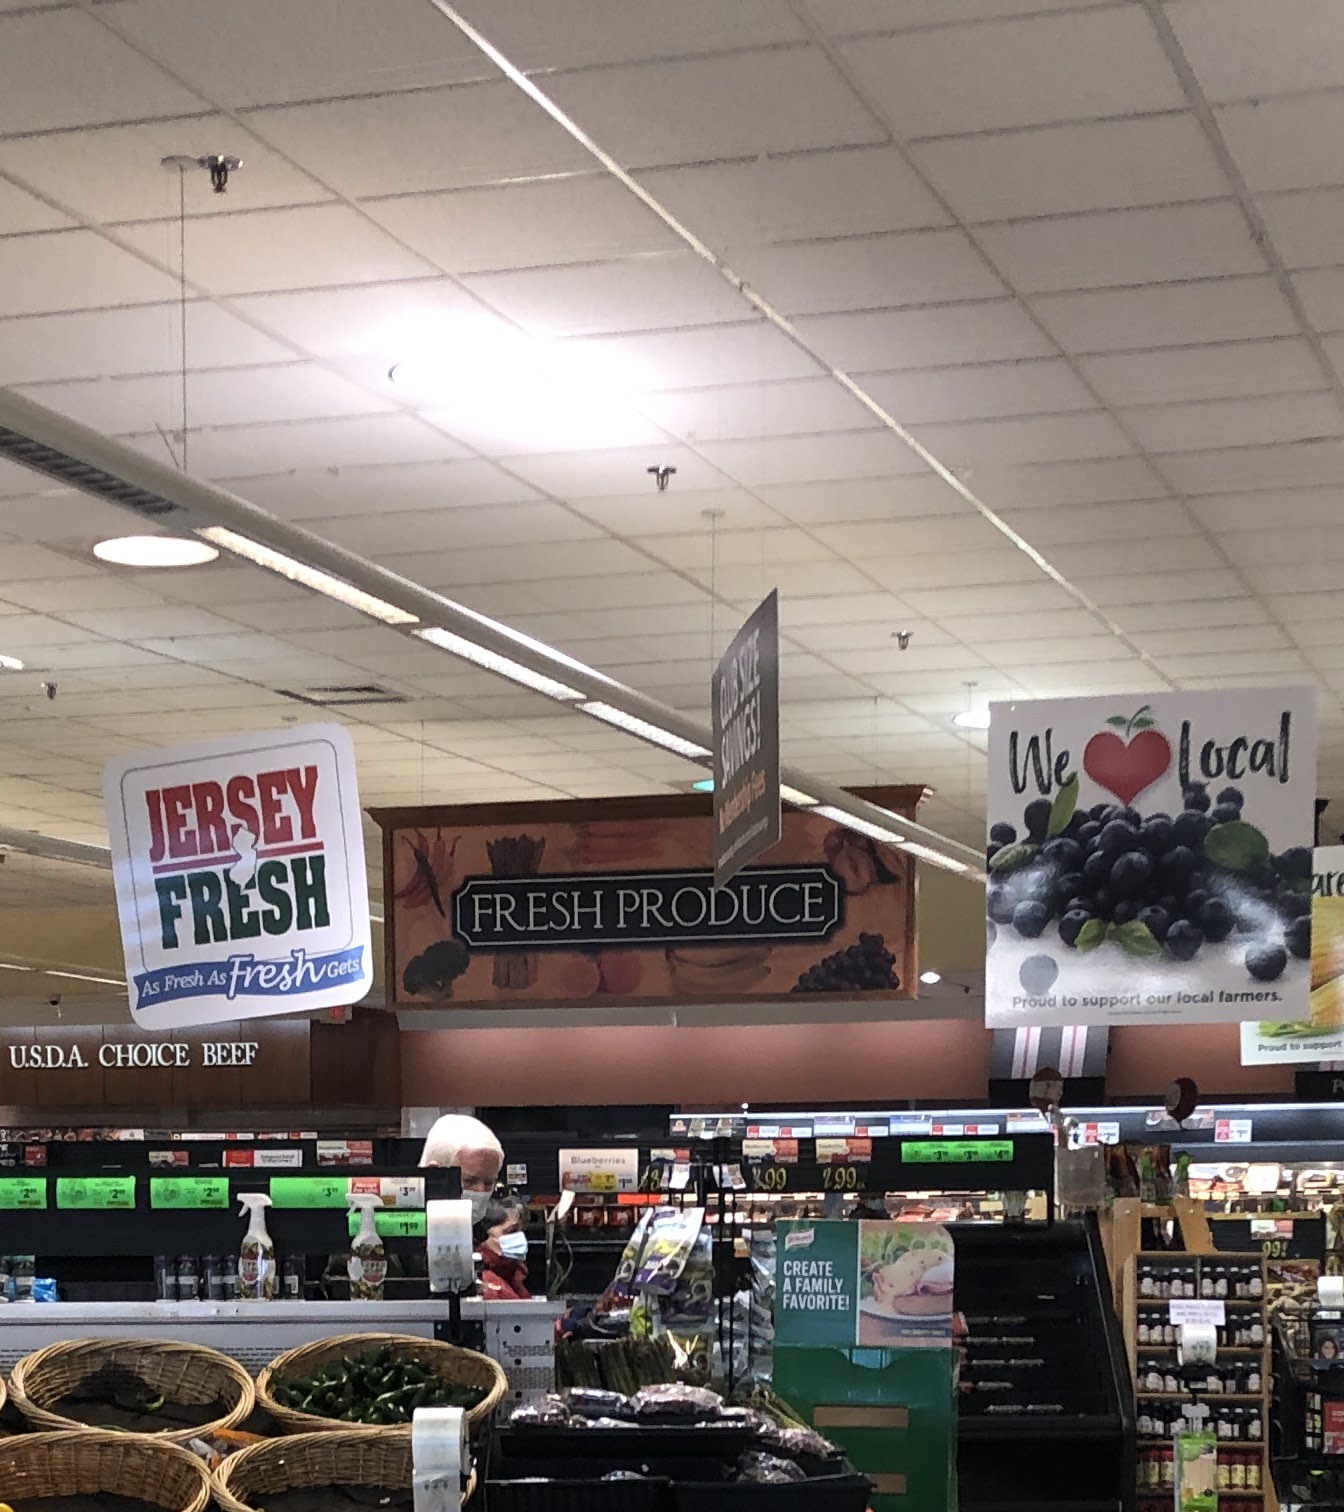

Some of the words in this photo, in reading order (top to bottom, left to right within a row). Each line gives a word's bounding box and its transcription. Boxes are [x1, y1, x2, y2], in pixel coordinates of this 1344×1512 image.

[1009, 727, 1077, 795] We
[1178, 710, 1291, 789] Local
[145, 764, 318, 863] JERSEY
[154, 854, 330, 949] FRESH
[471, 890, 602, 932] FRESH
[616, 882, 825, 929] PRODUCE
[141, 980, 160, 998] As
[164, 973, 204, 991] Fresh
[207, 969, 227, 986] As
[227, 950, 327, 999] Fresh
[327, 957, 360, 978] Gets
[1012, 994, 1057, 1009] Proud
[1062, 996, 1077, 1008] to
[1082, 994, 1141, 1011] support
[1146, 994, 1172, 1006] our
[1177, 991, 1214, 1005] local
[1218, 989, 1283, 1003] farmers.
[9, 1045, 89, 1069] U.S.D.A.
[98, 1042, 190, 1067] CHOICE
[202, 1041, 259, 1066] BEEF
[571, 1156, 625, 1165] Blueberries
[783, 1260, 833, 1276] CREATE
[783, 1278, 792, 1292] A
[796, 1278, 843, 1293] FAMILY
[783, 1294, 849, 1310] FAVORITE!
